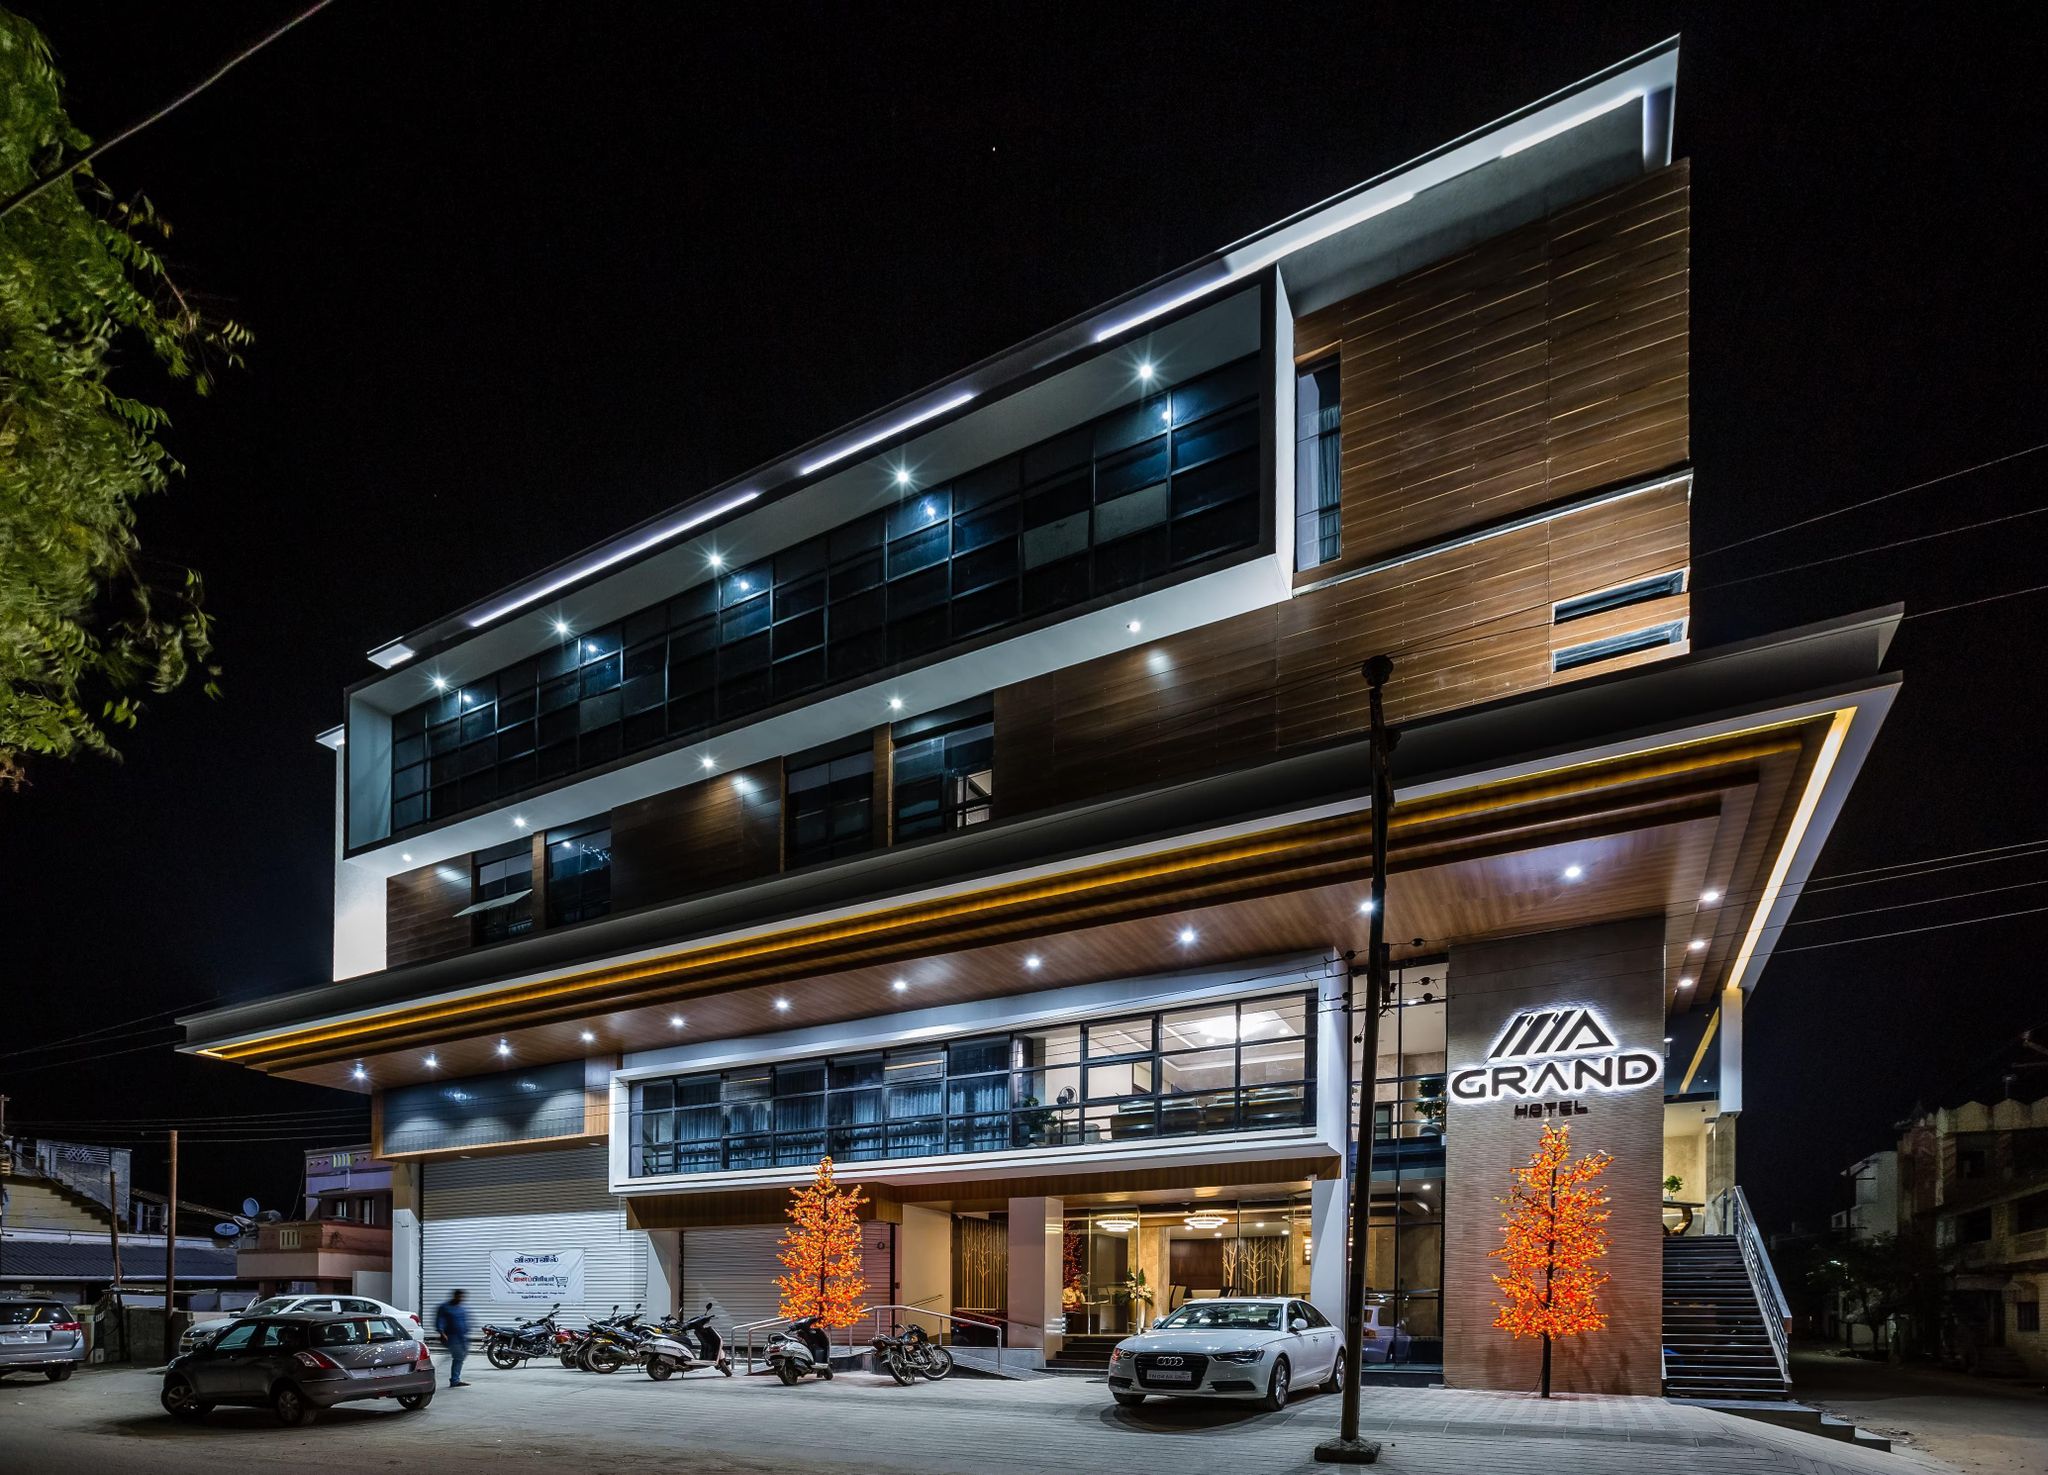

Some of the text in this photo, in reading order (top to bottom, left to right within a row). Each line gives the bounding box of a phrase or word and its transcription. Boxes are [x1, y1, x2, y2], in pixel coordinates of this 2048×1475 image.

[1451, 1053, 1658, 1099] GRAND
[1514, 1100, 1588, 1119] HOTEL
[514, 1254, 559, 1264] விரைவில்
